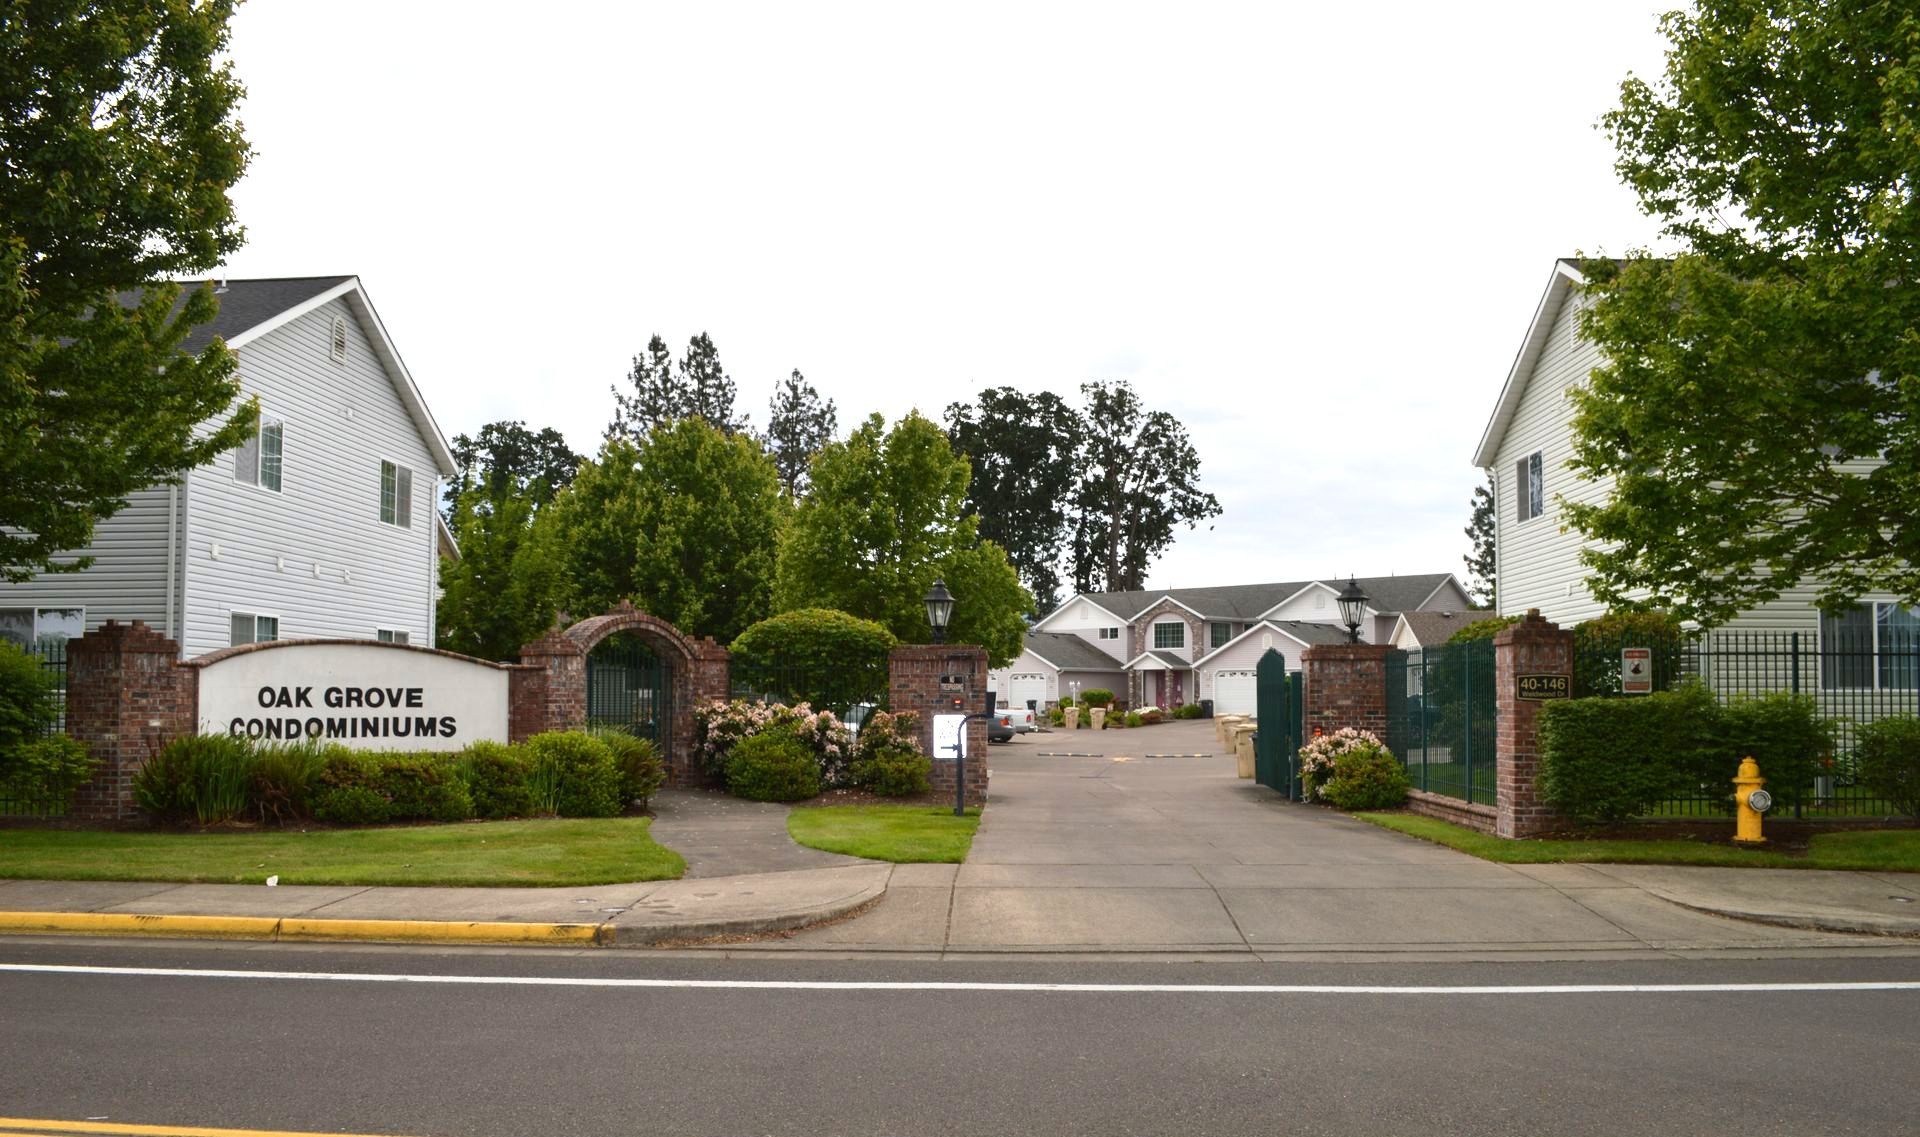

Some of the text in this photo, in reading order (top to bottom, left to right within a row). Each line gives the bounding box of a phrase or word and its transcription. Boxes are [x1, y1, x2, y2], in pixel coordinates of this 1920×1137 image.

[1520, 678, 1566, 690] 40-146
[258, 686, 423, 709] OAK GROVE
[229, 716, 457, 740] CONDOMINIUMS
